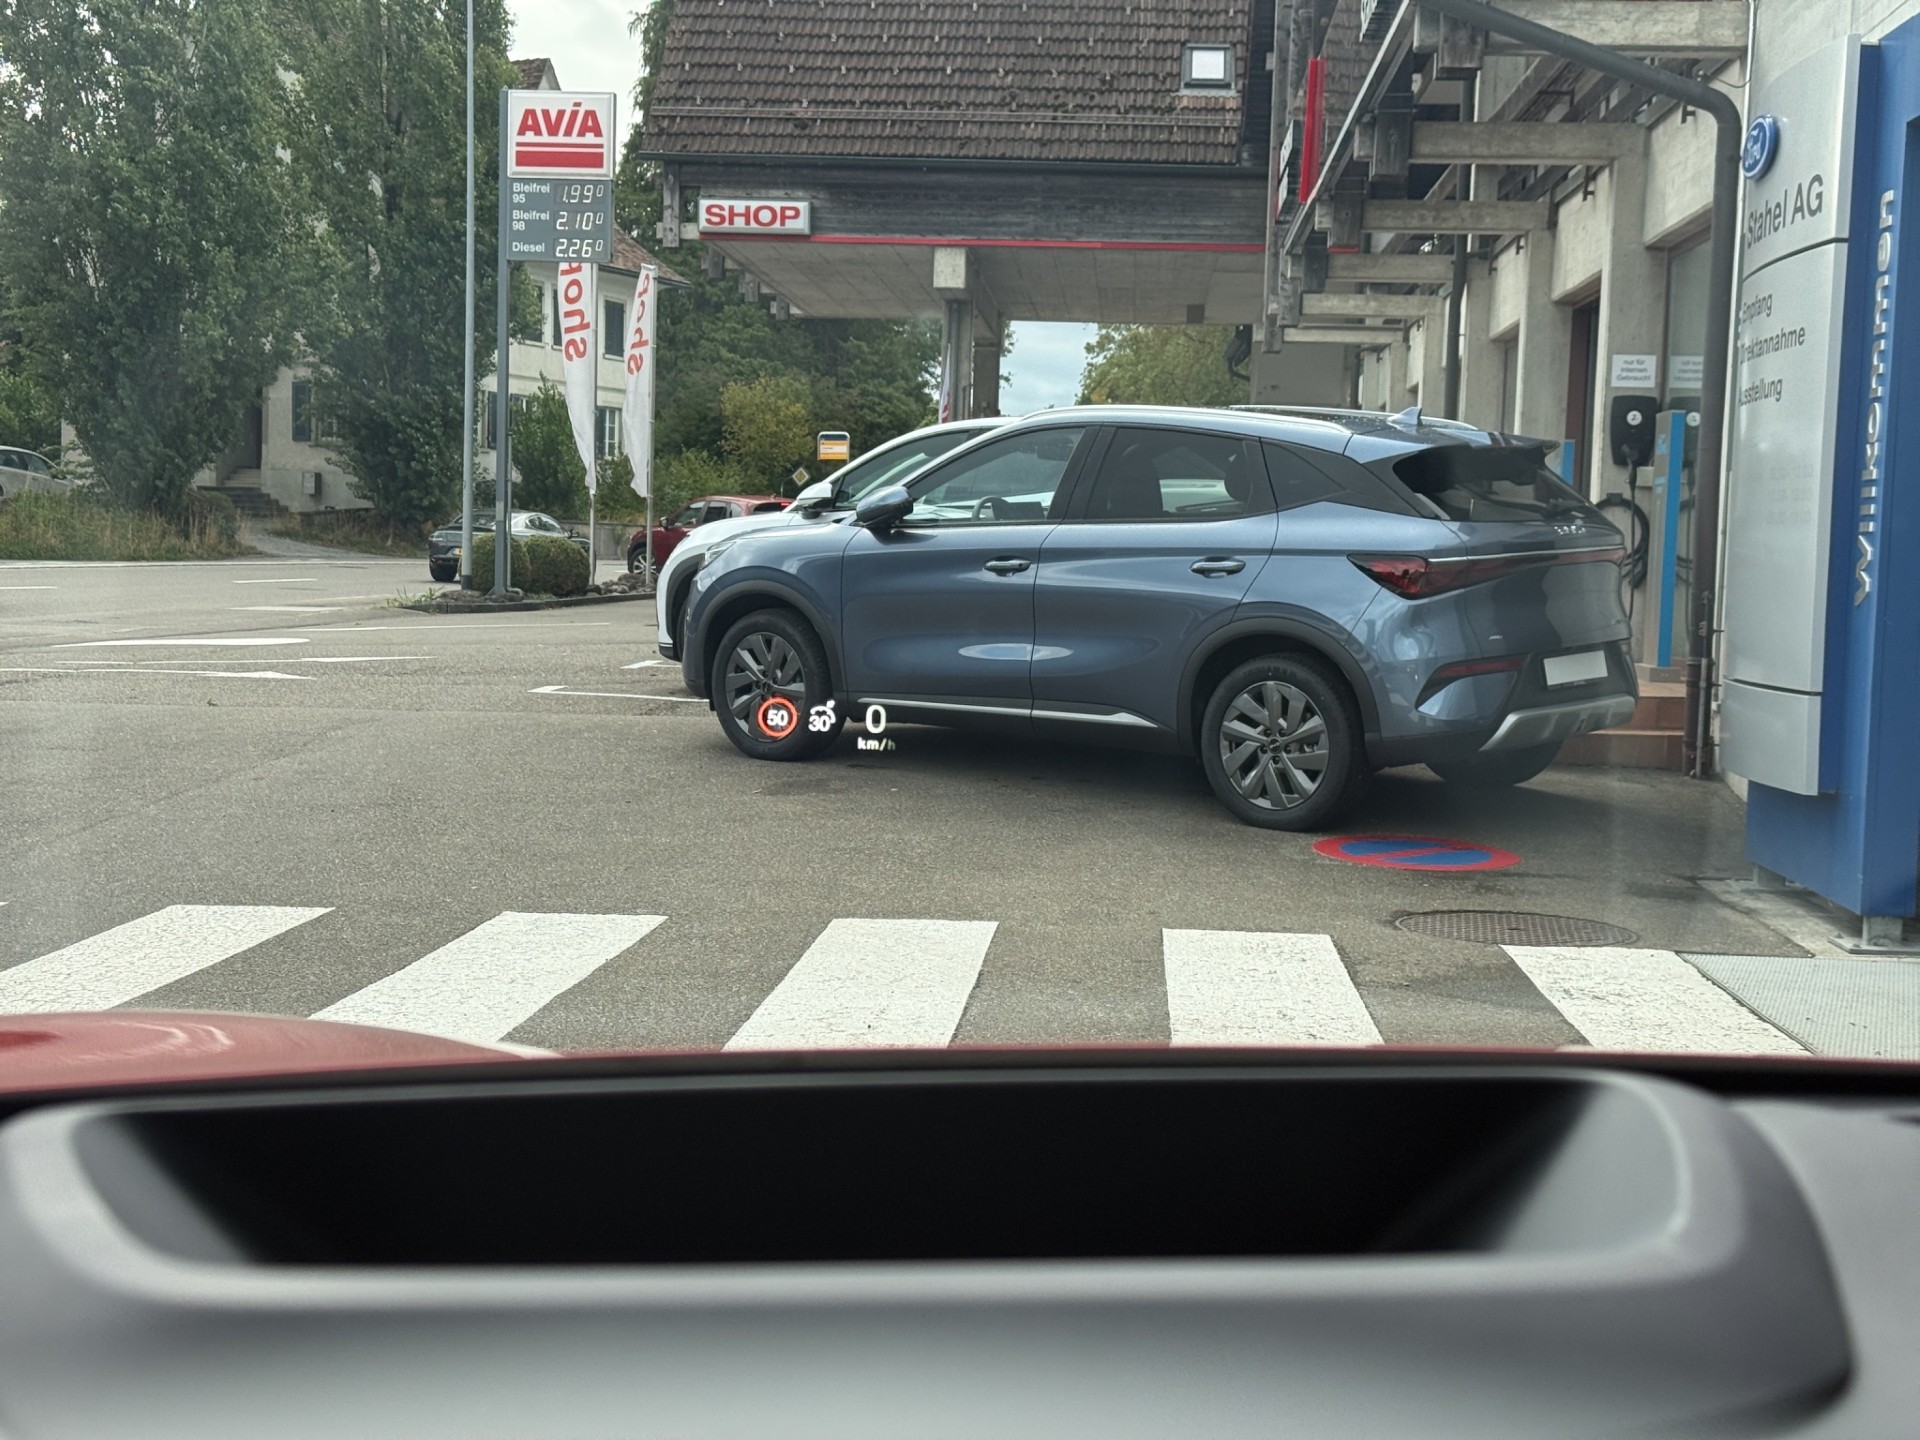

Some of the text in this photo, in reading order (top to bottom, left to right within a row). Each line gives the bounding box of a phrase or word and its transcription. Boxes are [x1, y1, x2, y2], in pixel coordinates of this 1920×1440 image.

[516, 102, 603, 137] AVIA
[512, 183, 550, 193] Bleifrei
[512, 194, 526, 203] 95
[512, 210, 550, 220] Bleifrei
[705, 204, 801, 227] SHOP
[1747, 174, 1823, 249] Stahel AG
[512, 221, 525, 230] 98
[512, 242, 545, 252] Diesel
[1740, 327, 1806, 365] Dektannahme
[1854, 189, 1894, 606] Willkommen
[766, 709, 789, 726] 50
[808, 715, 831, 732] 30
[865, 705, 887, 734] 0
[857, 737, 896, 751] km/h
